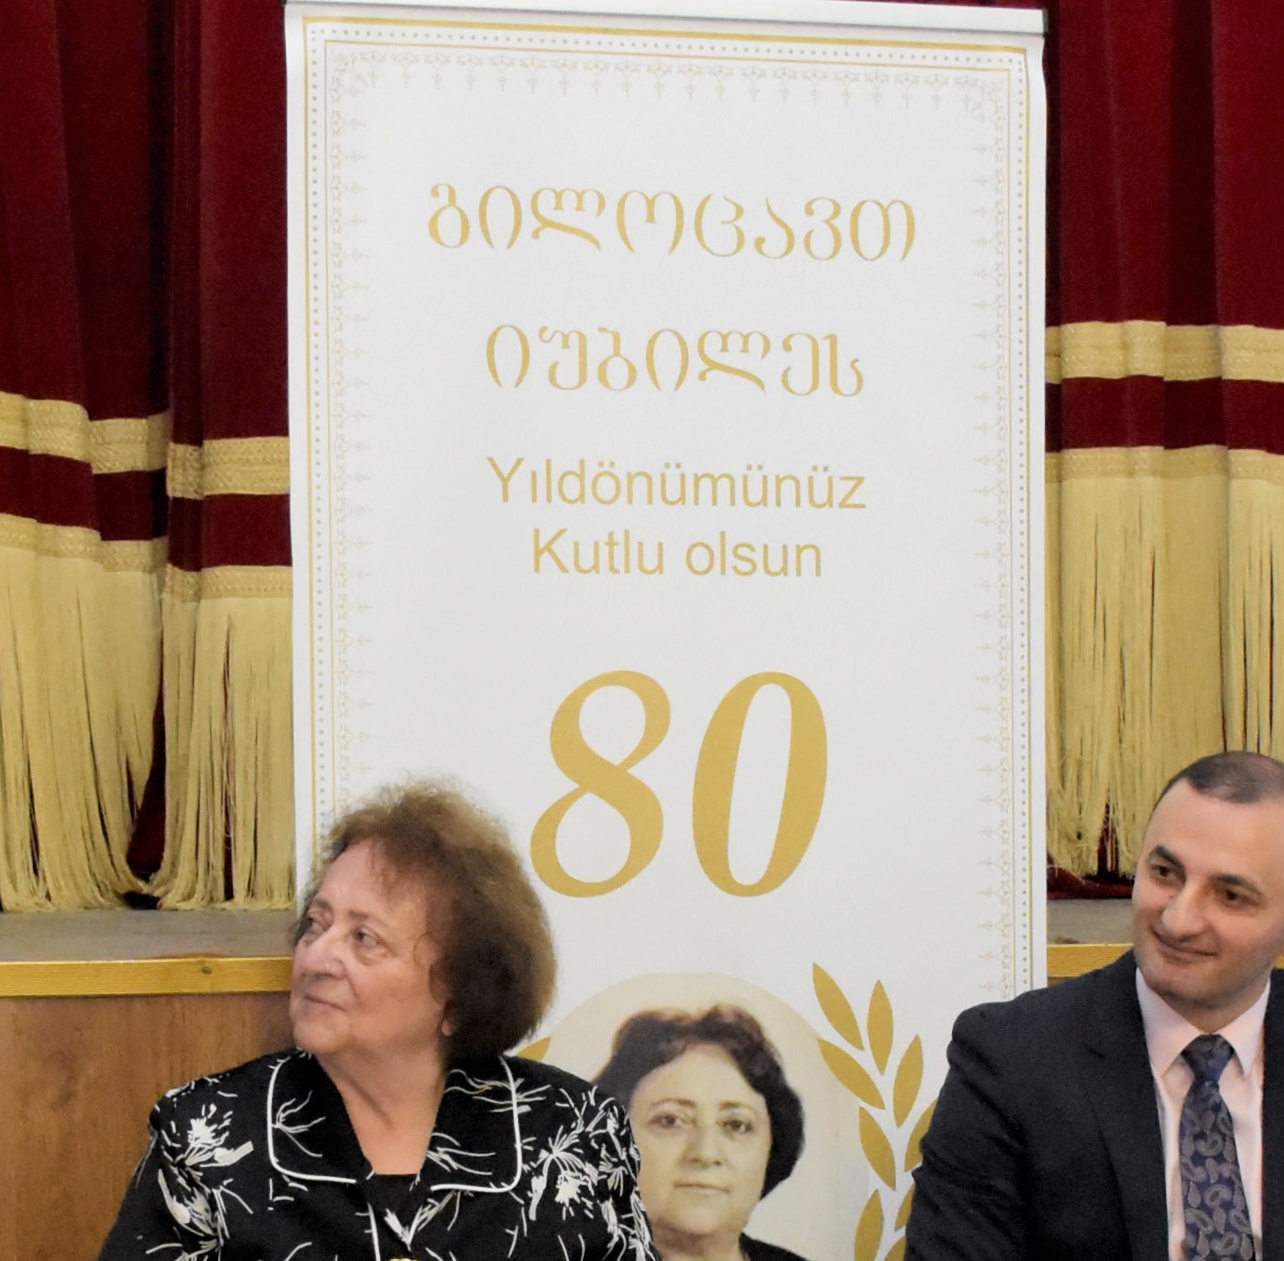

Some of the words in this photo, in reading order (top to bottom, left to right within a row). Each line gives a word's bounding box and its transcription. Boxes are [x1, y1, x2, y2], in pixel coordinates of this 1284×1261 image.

[427, 182, 917, 262] გილოცავთ
[485, 324, 865, 397] იუბილეს
[486, 456, 867, 510] Yıldönümünüz
[532, 527, 665, 576] Kutlu
[685, 530, 823, 578] olsun
[529, 669, 829, 899] 80
